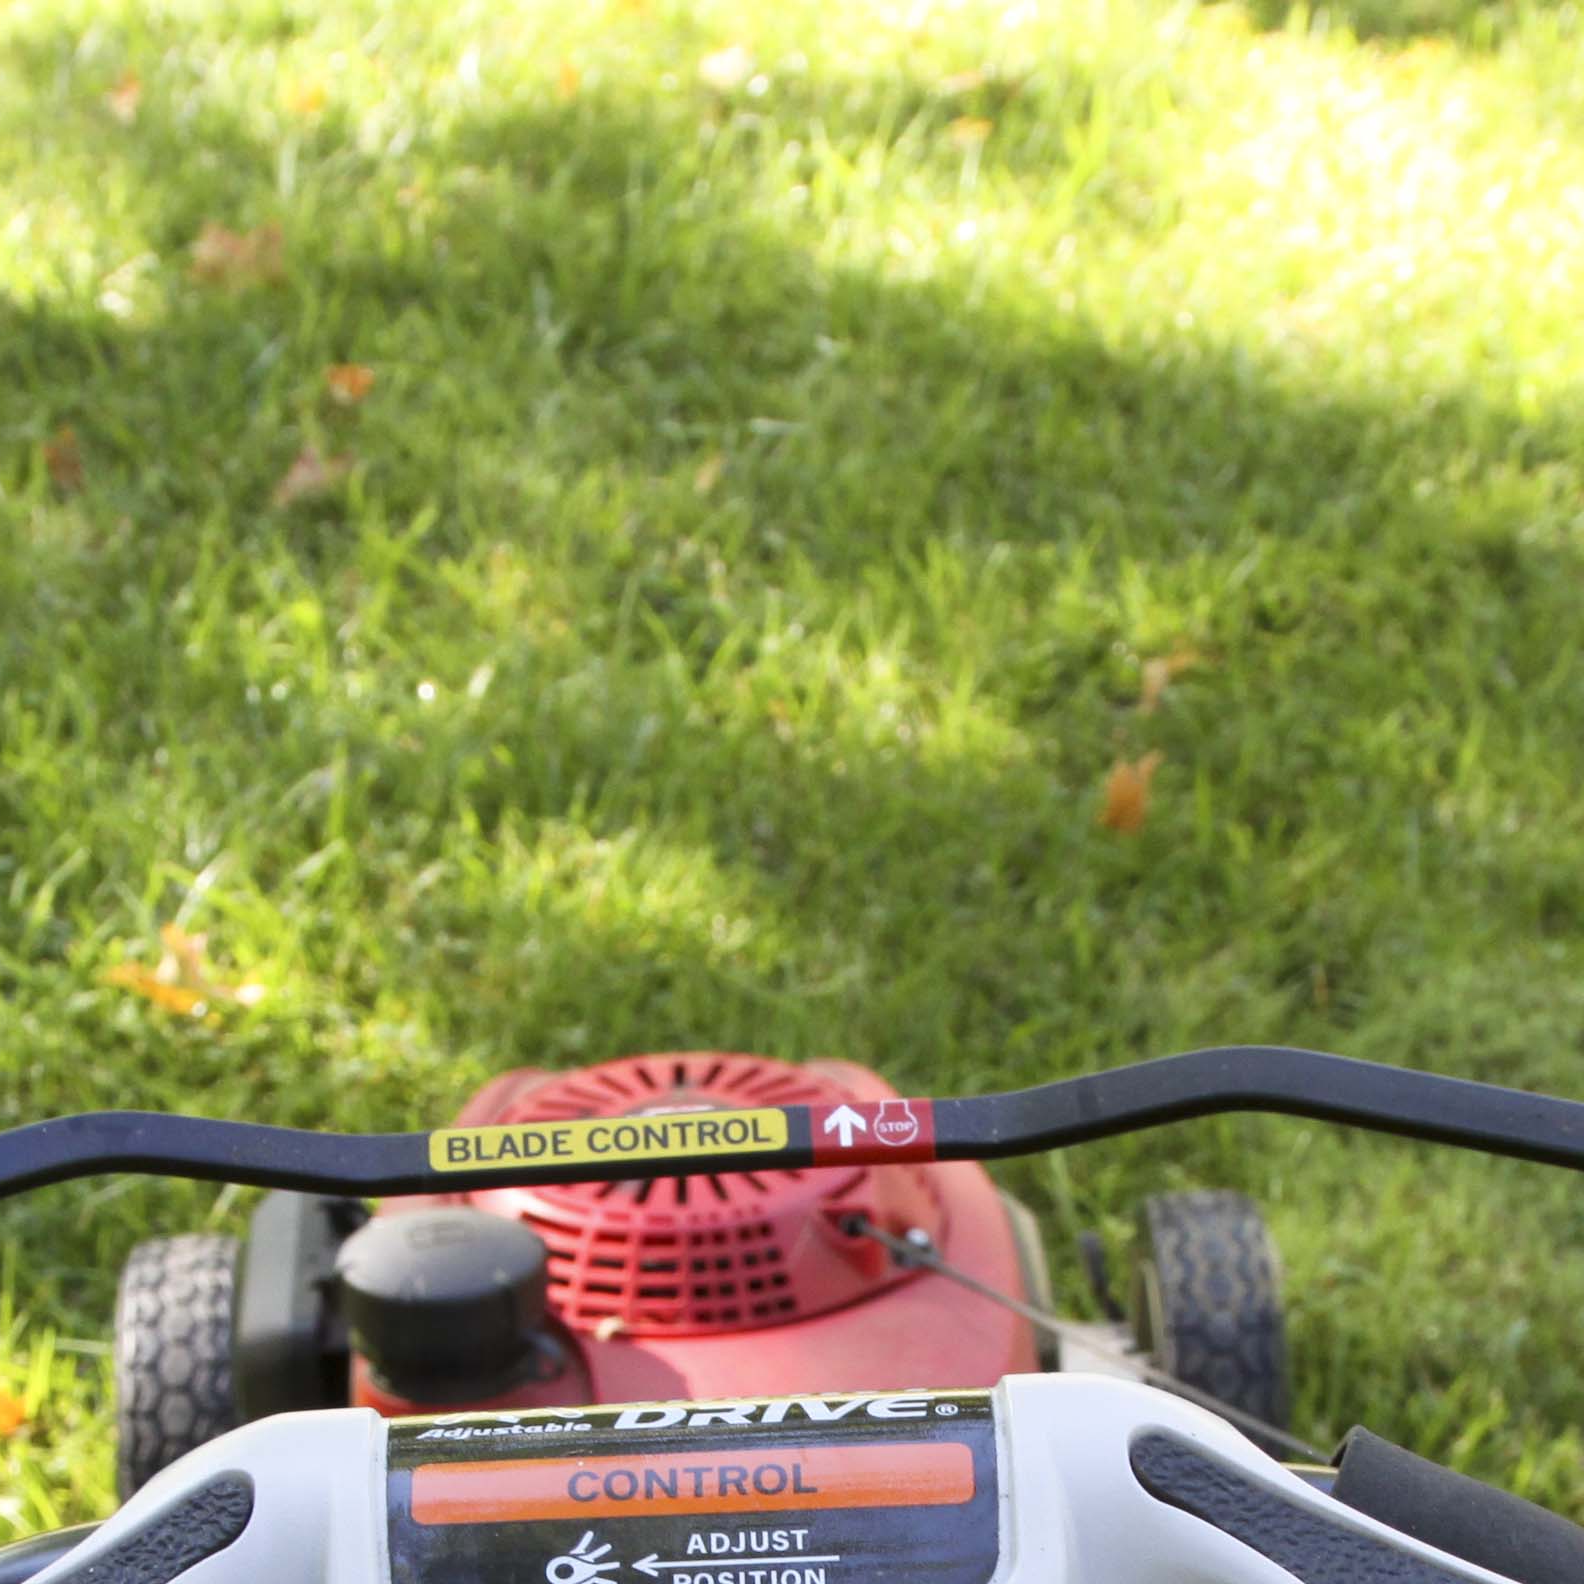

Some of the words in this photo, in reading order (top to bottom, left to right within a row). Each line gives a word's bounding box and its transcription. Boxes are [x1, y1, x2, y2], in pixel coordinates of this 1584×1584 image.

[446, 1127, 573, 1163] BLADE
[586, 1117, 772, 1154] CONTROL
[878, 1121, 914, 1134] STOP
[416, 1422, 593, 1441] Adjustable
[567, 1462, 818, 1503] CONTROL
[686, 1529, 809, 1555] ADJUST
